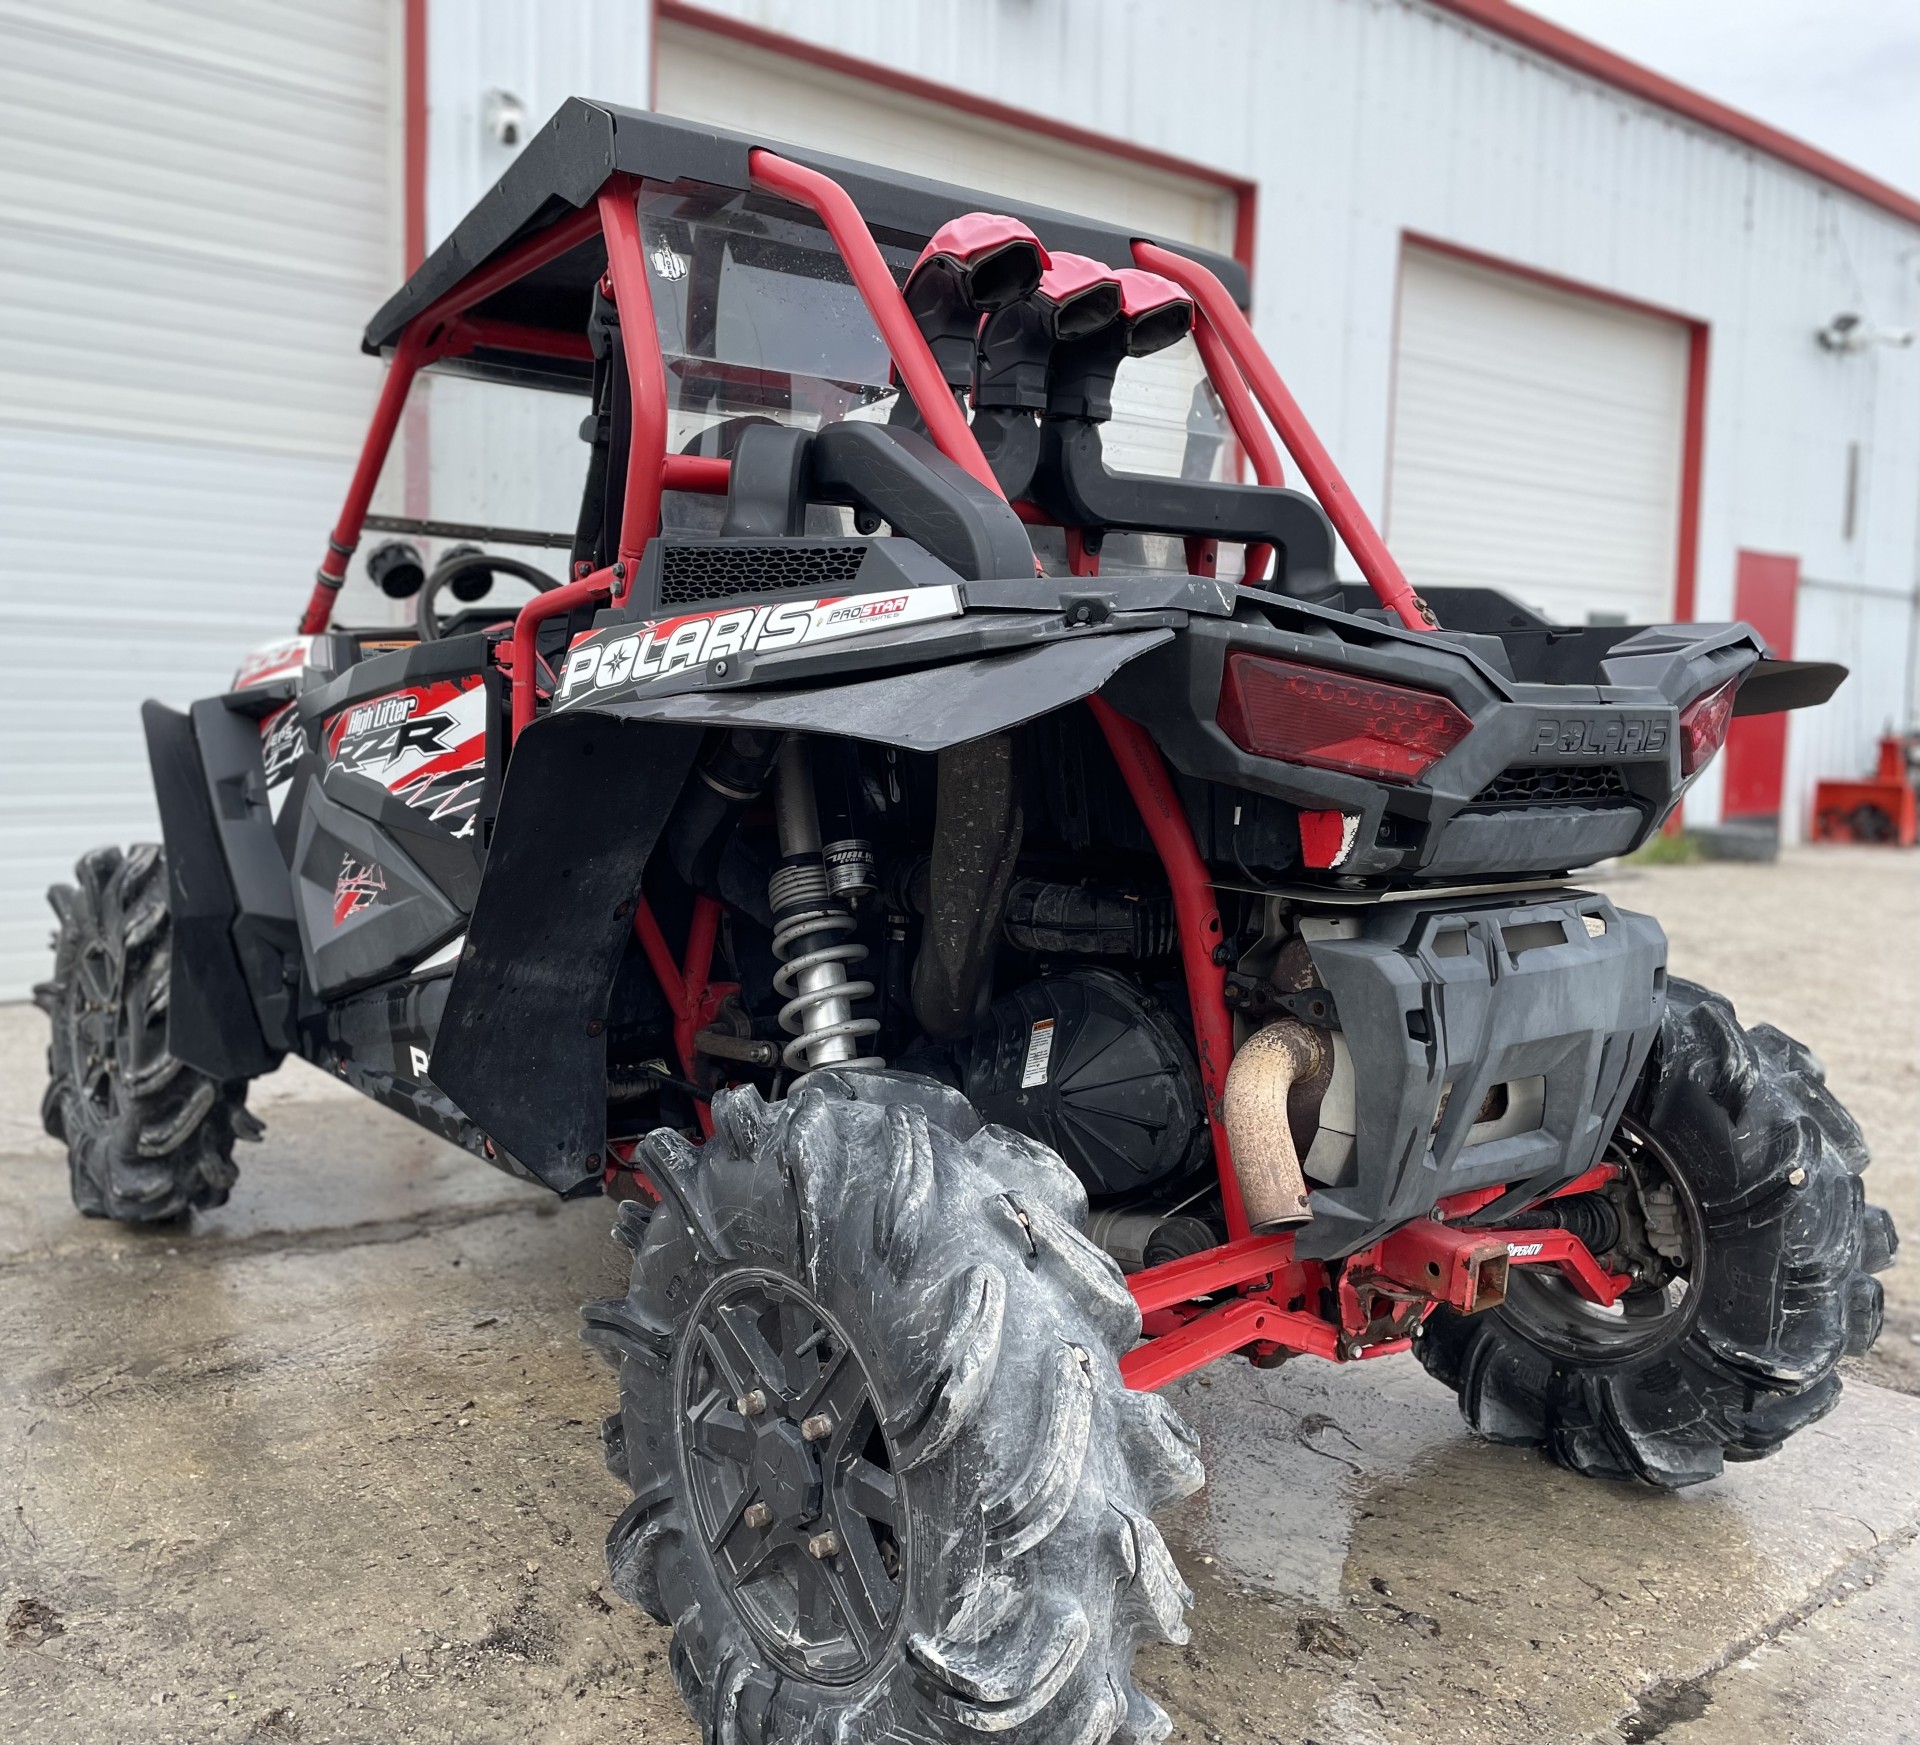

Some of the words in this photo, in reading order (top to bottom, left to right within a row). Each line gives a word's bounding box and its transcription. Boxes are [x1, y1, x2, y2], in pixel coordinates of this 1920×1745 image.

[827, 596, 909, 624] PROSTAR
[859, 612, 900, 624] ENGINES
[559, 599, 818, 701] POLARIS
[348, 704, 375, 735] High
[373, 697, 417, 727] Lifter
[270, 726, 293, 746] EPS
[333, 712, 460, 773] RZR
[1530, 719, 1670, 755] POLARIS
